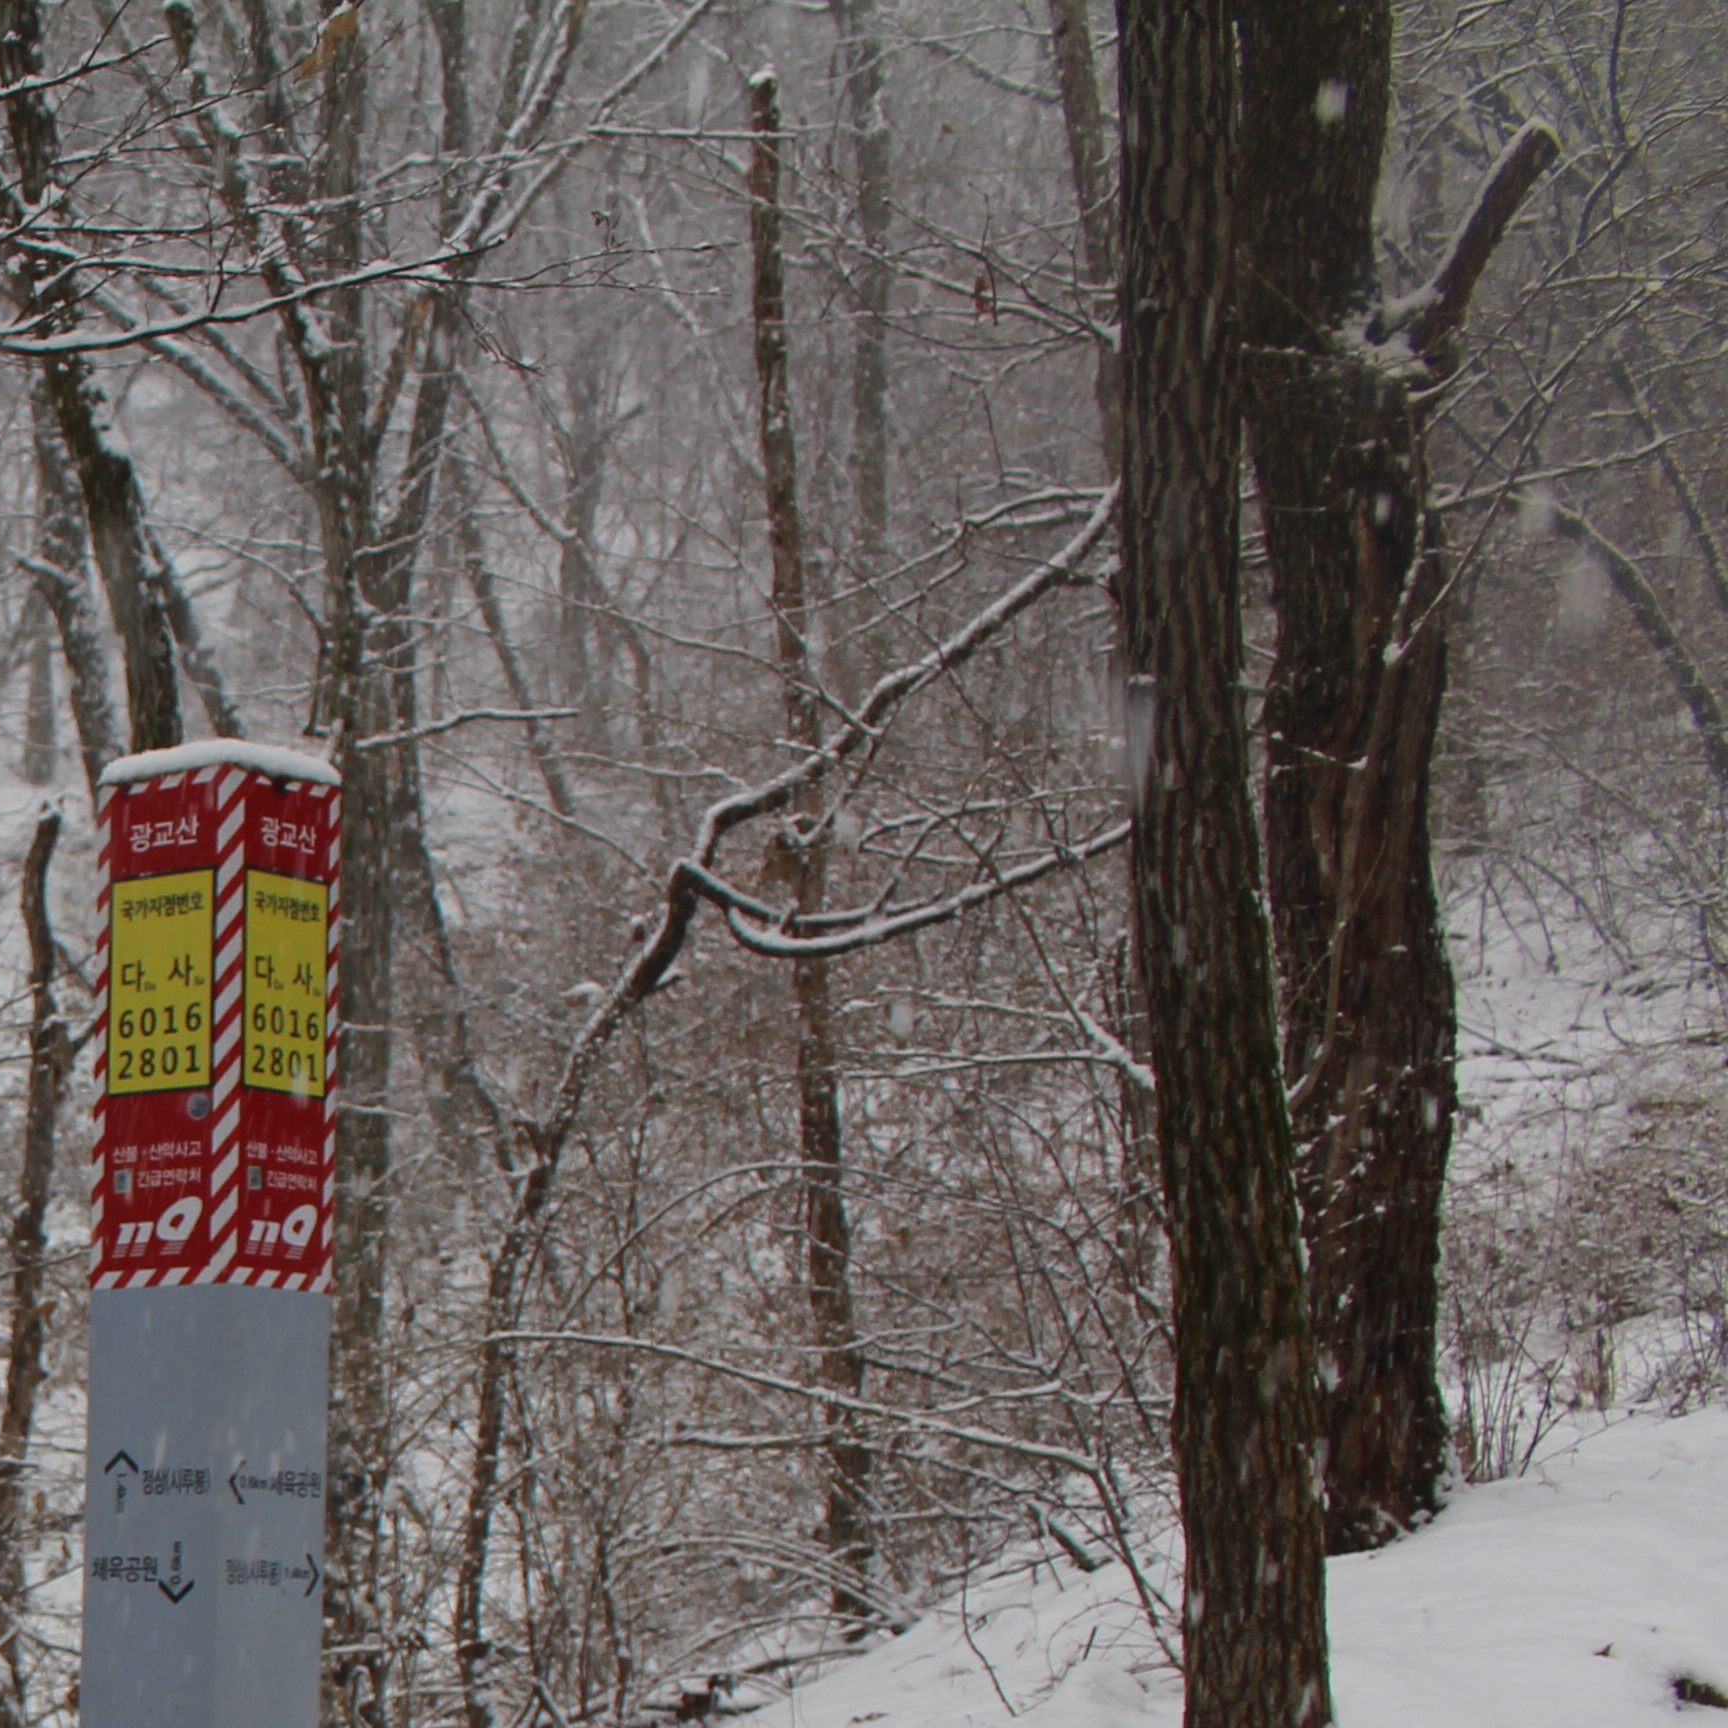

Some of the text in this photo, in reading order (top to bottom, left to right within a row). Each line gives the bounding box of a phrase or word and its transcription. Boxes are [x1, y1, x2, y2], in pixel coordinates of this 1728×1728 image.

[127, 814, 200, 853] 광교산
[260, 815, 317, 854] 광교산
[121, 891, 205, 921] 국가지점번호
[253, 890, 322, 922] 국가지점번호
[122, 958, 146, 992] 다
[168, 953, 194, 986] 사
[255, 955, 275, 988] 다
[293, 962, 313, 995] 사
[119, 1001, 203, 1039] 6016
[253, 1003, 319, 1042] 6016
[118, 1044, 201, 1080] 2801
[252, 1044, 318, 1083] 2801
[112, 1140, 202, 1164] 산불 산악사고
[137, 1166, 202, 1188] 긴급연락처
[267, 1170, 317, 1192] 긴급연락처
[112, 1195, 203, 1256] 119
[245, 1204, 318, 1257] 119
[270, 1470, 321, 1498] 체육공원
[92, 1555, 158, 1582] 체육공원
